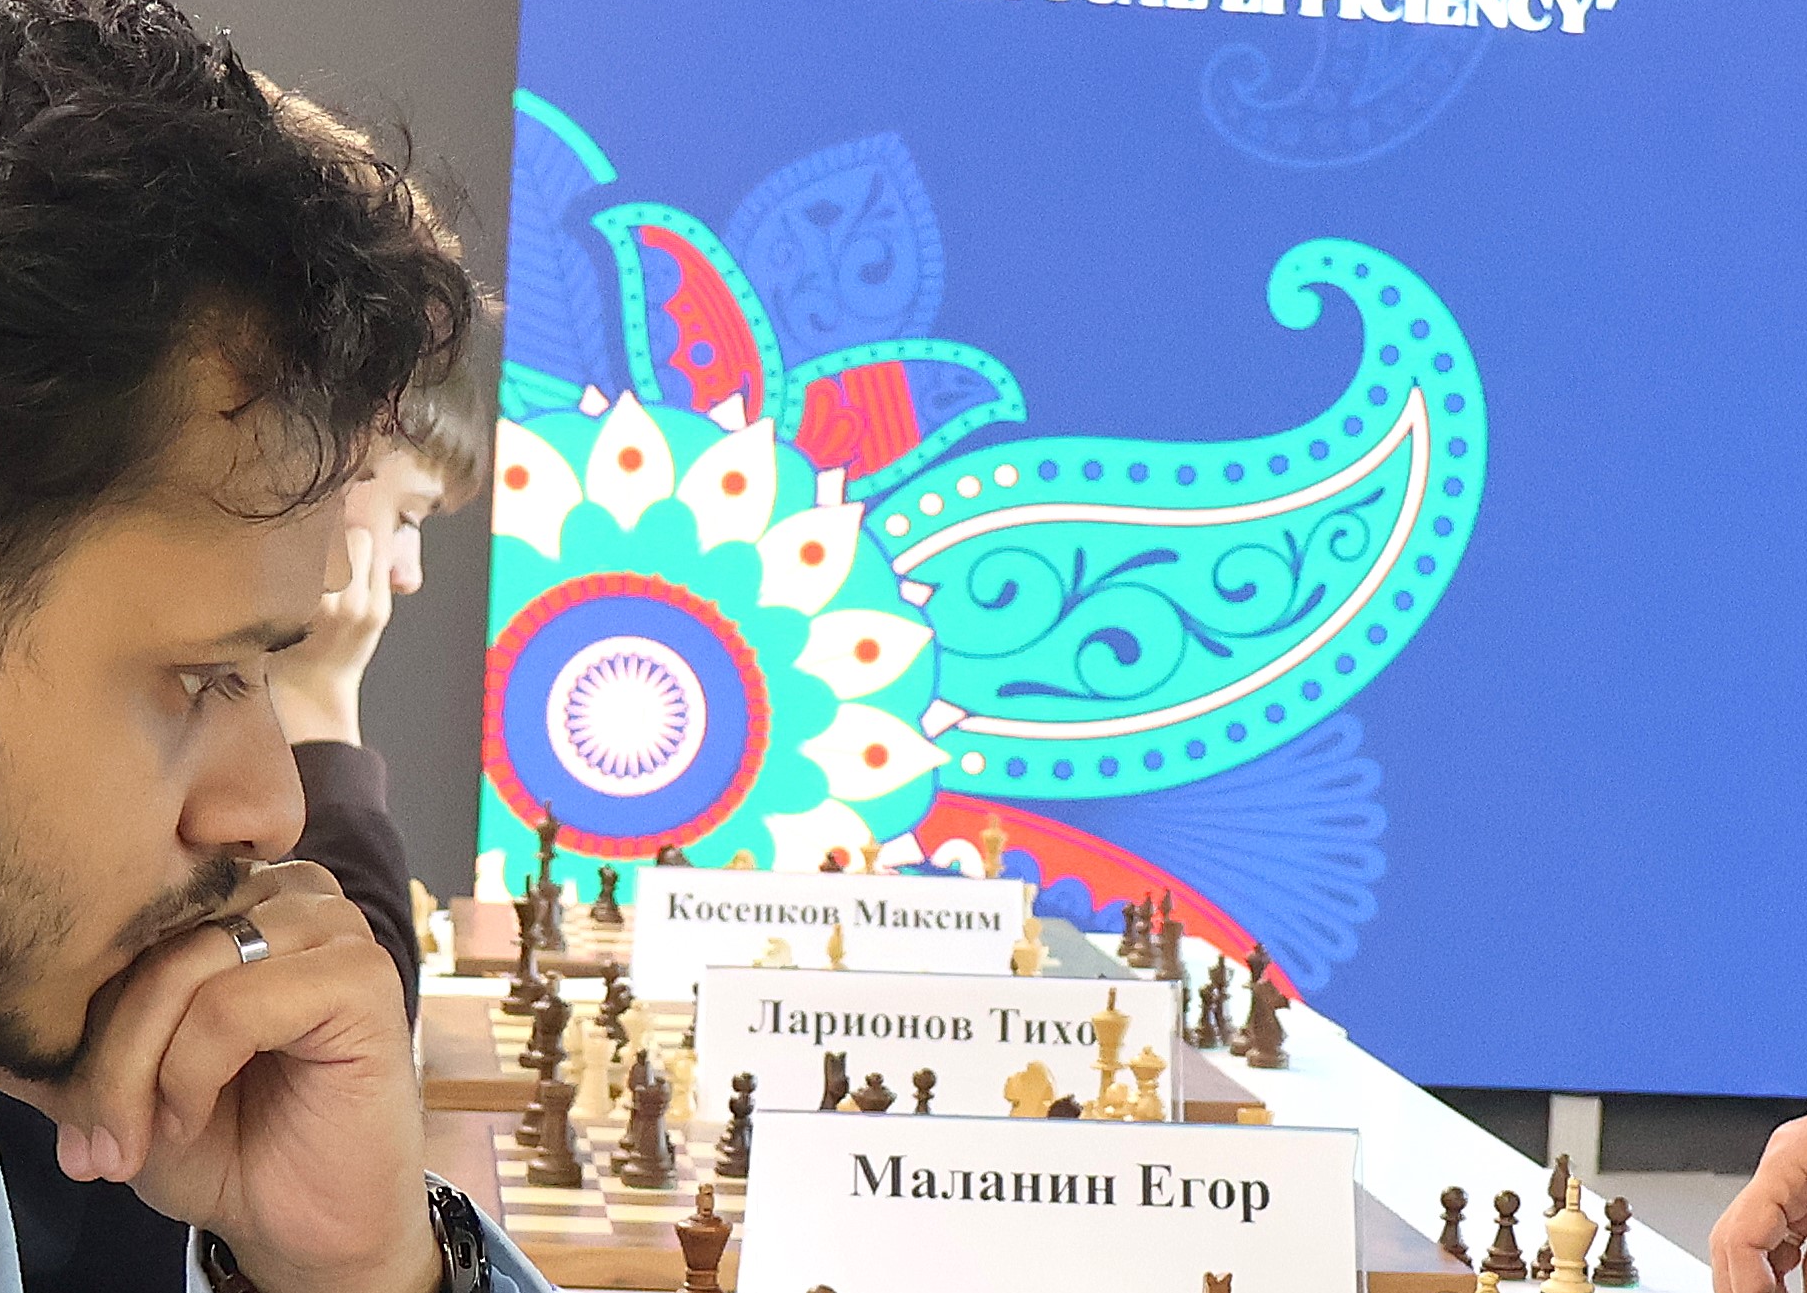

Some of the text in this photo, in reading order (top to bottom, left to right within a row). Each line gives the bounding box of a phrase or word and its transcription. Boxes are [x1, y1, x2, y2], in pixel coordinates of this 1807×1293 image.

[667, 894, 1001, 930] Косенков Максим
[749, 999, 1097, 1047] Ларионов Тихо
[850, 1155, 1269, 1222] Маланин Егор
